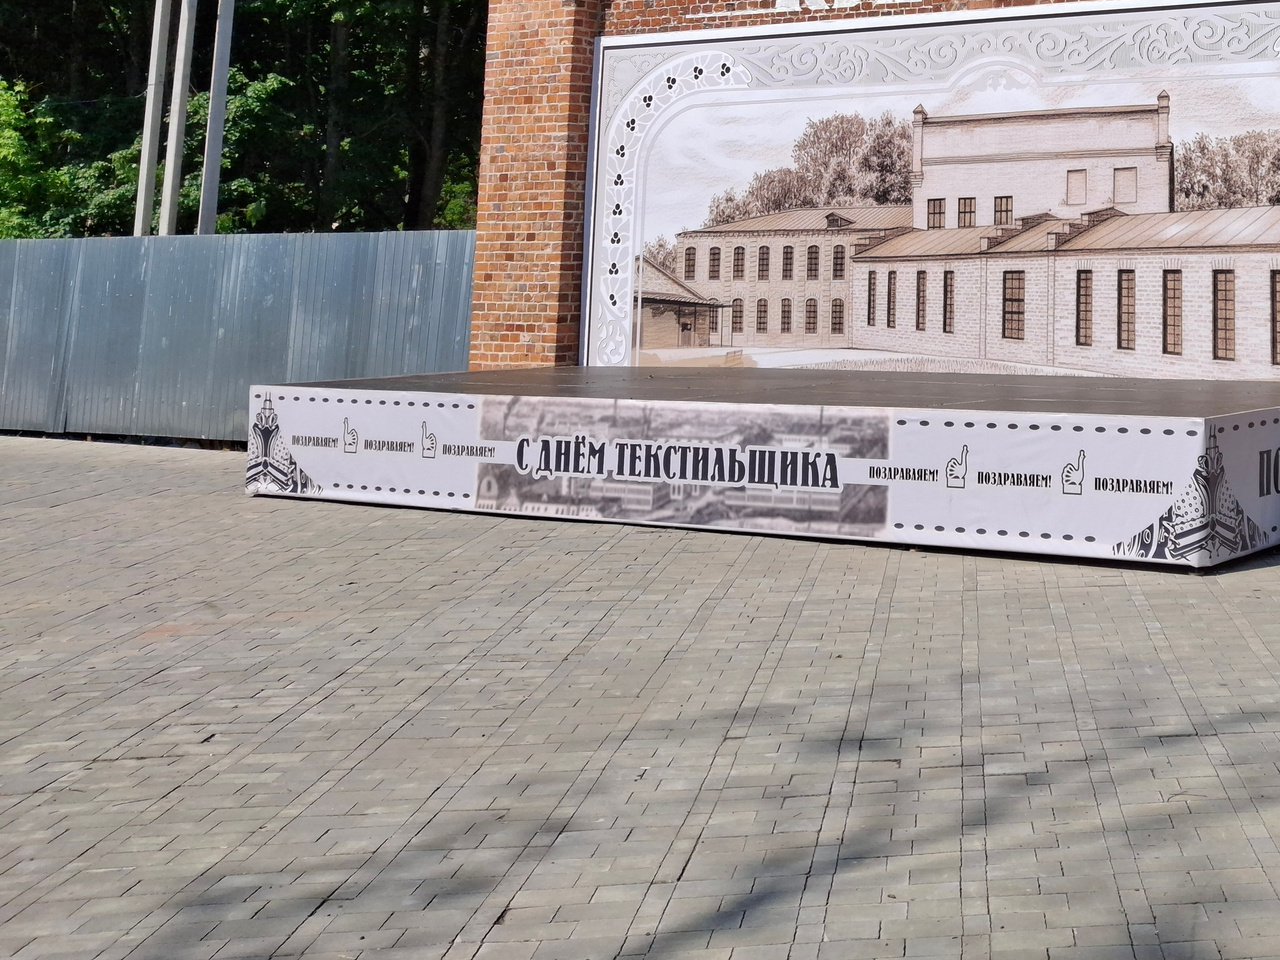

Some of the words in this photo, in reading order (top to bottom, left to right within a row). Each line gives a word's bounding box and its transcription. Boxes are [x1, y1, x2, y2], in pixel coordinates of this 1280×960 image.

[442, 443, 496, 458] ПОЗДРАВЛЯЕМ!
[516, 438, 530, 470] С
[536, 435, 607, 476] ДНЁМ
[615, 442, 840, 489] ТЕКСТИЛЬЩИКА
[868, 466, 939, 482] ПОЗДРАВЛЯЕМ!
[977, 471, 1052, 488] ПОЗДРАВЛЯЕМ!
[1094, 477, 1174, 495] ПОЗДРАВЛЯЕМ!
